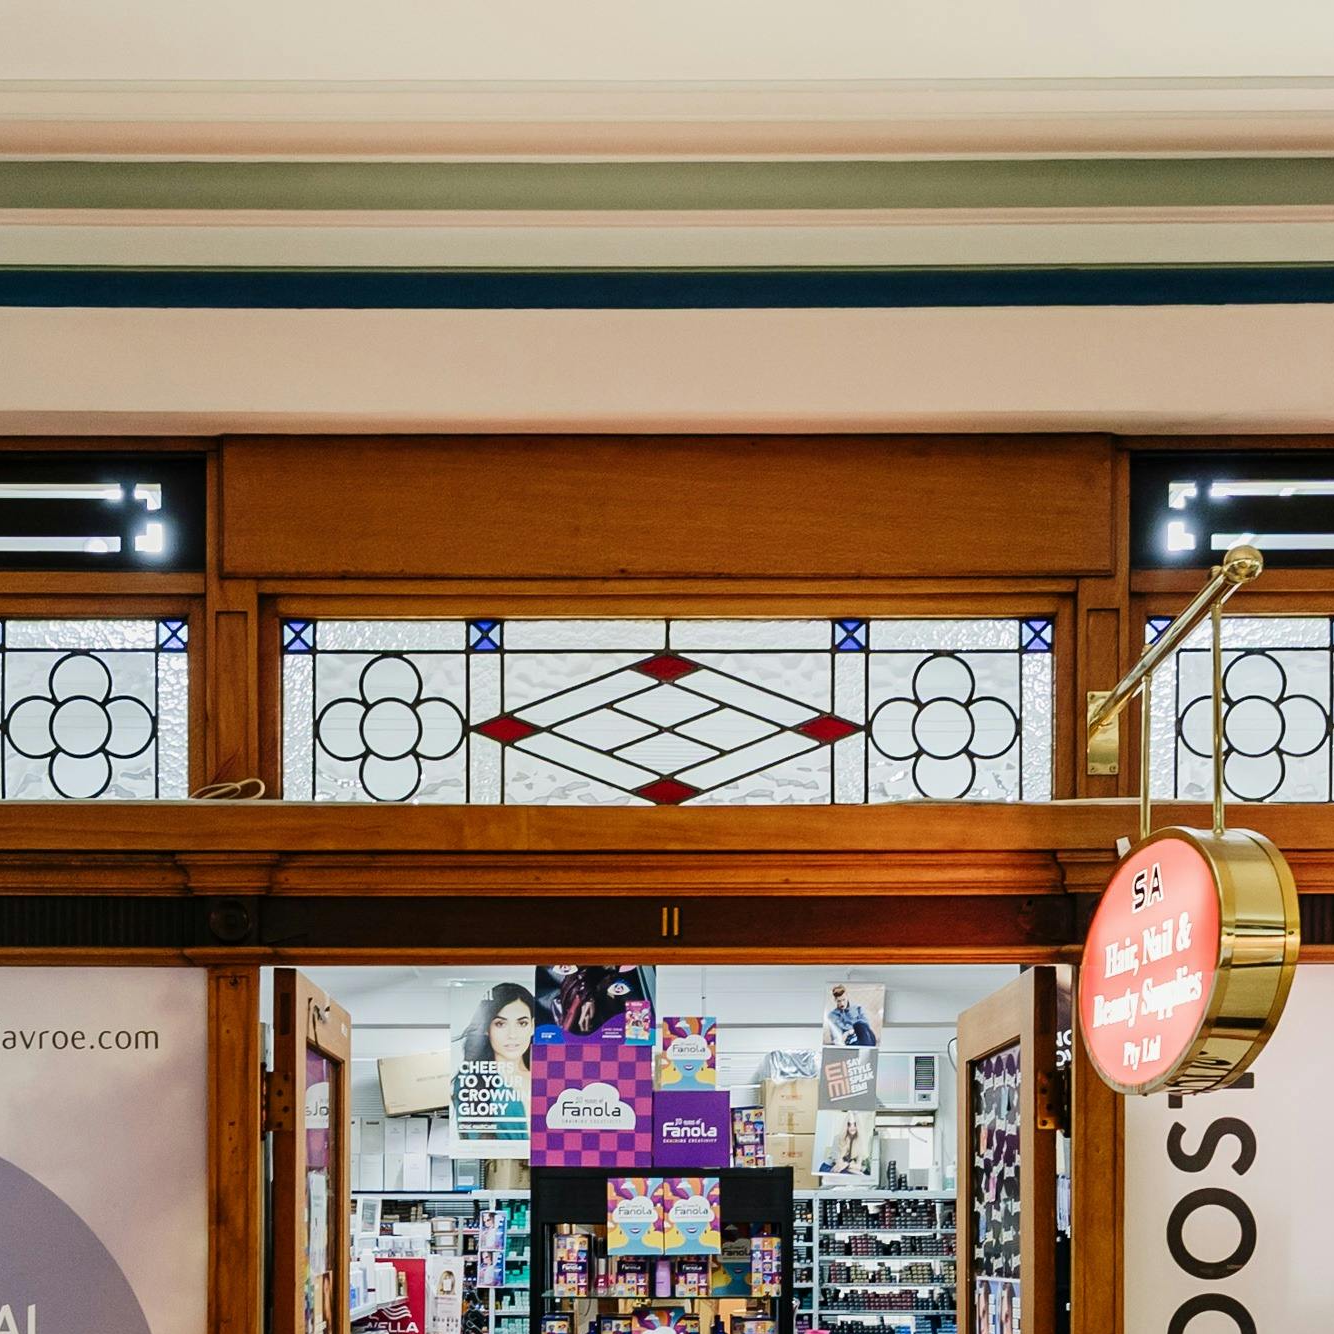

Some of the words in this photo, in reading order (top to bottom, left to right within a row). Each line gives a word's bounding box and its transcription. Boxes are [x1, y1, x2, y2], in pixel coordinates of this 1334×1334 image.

[1132, 862, 1164, 914] SA
[1104, 936, 1139, 979] Hair,
[1141, 918, 1174, 965] Nail
[1175, 911, 1192, 952] &
[1093, 988, 1140, 1028] Beauty
[1141, 965, 1203, 1021] Supplies
[672, 1044, 706, 1053] Fanola
[460, 1060, 515, 1074] CHEERS
[458, 1075, 478, 1088] TO
[482, 1075, 524, 1088] YOUR
[458, 1103, 508, 1116] GLORY
[562, 1101, 621, 1117] Fanola
[662, 1121, 717, 1137] Fanola
[618, 1206, 653, 1216] Fanola
[674, 1206, 709, 1216] Fanola
